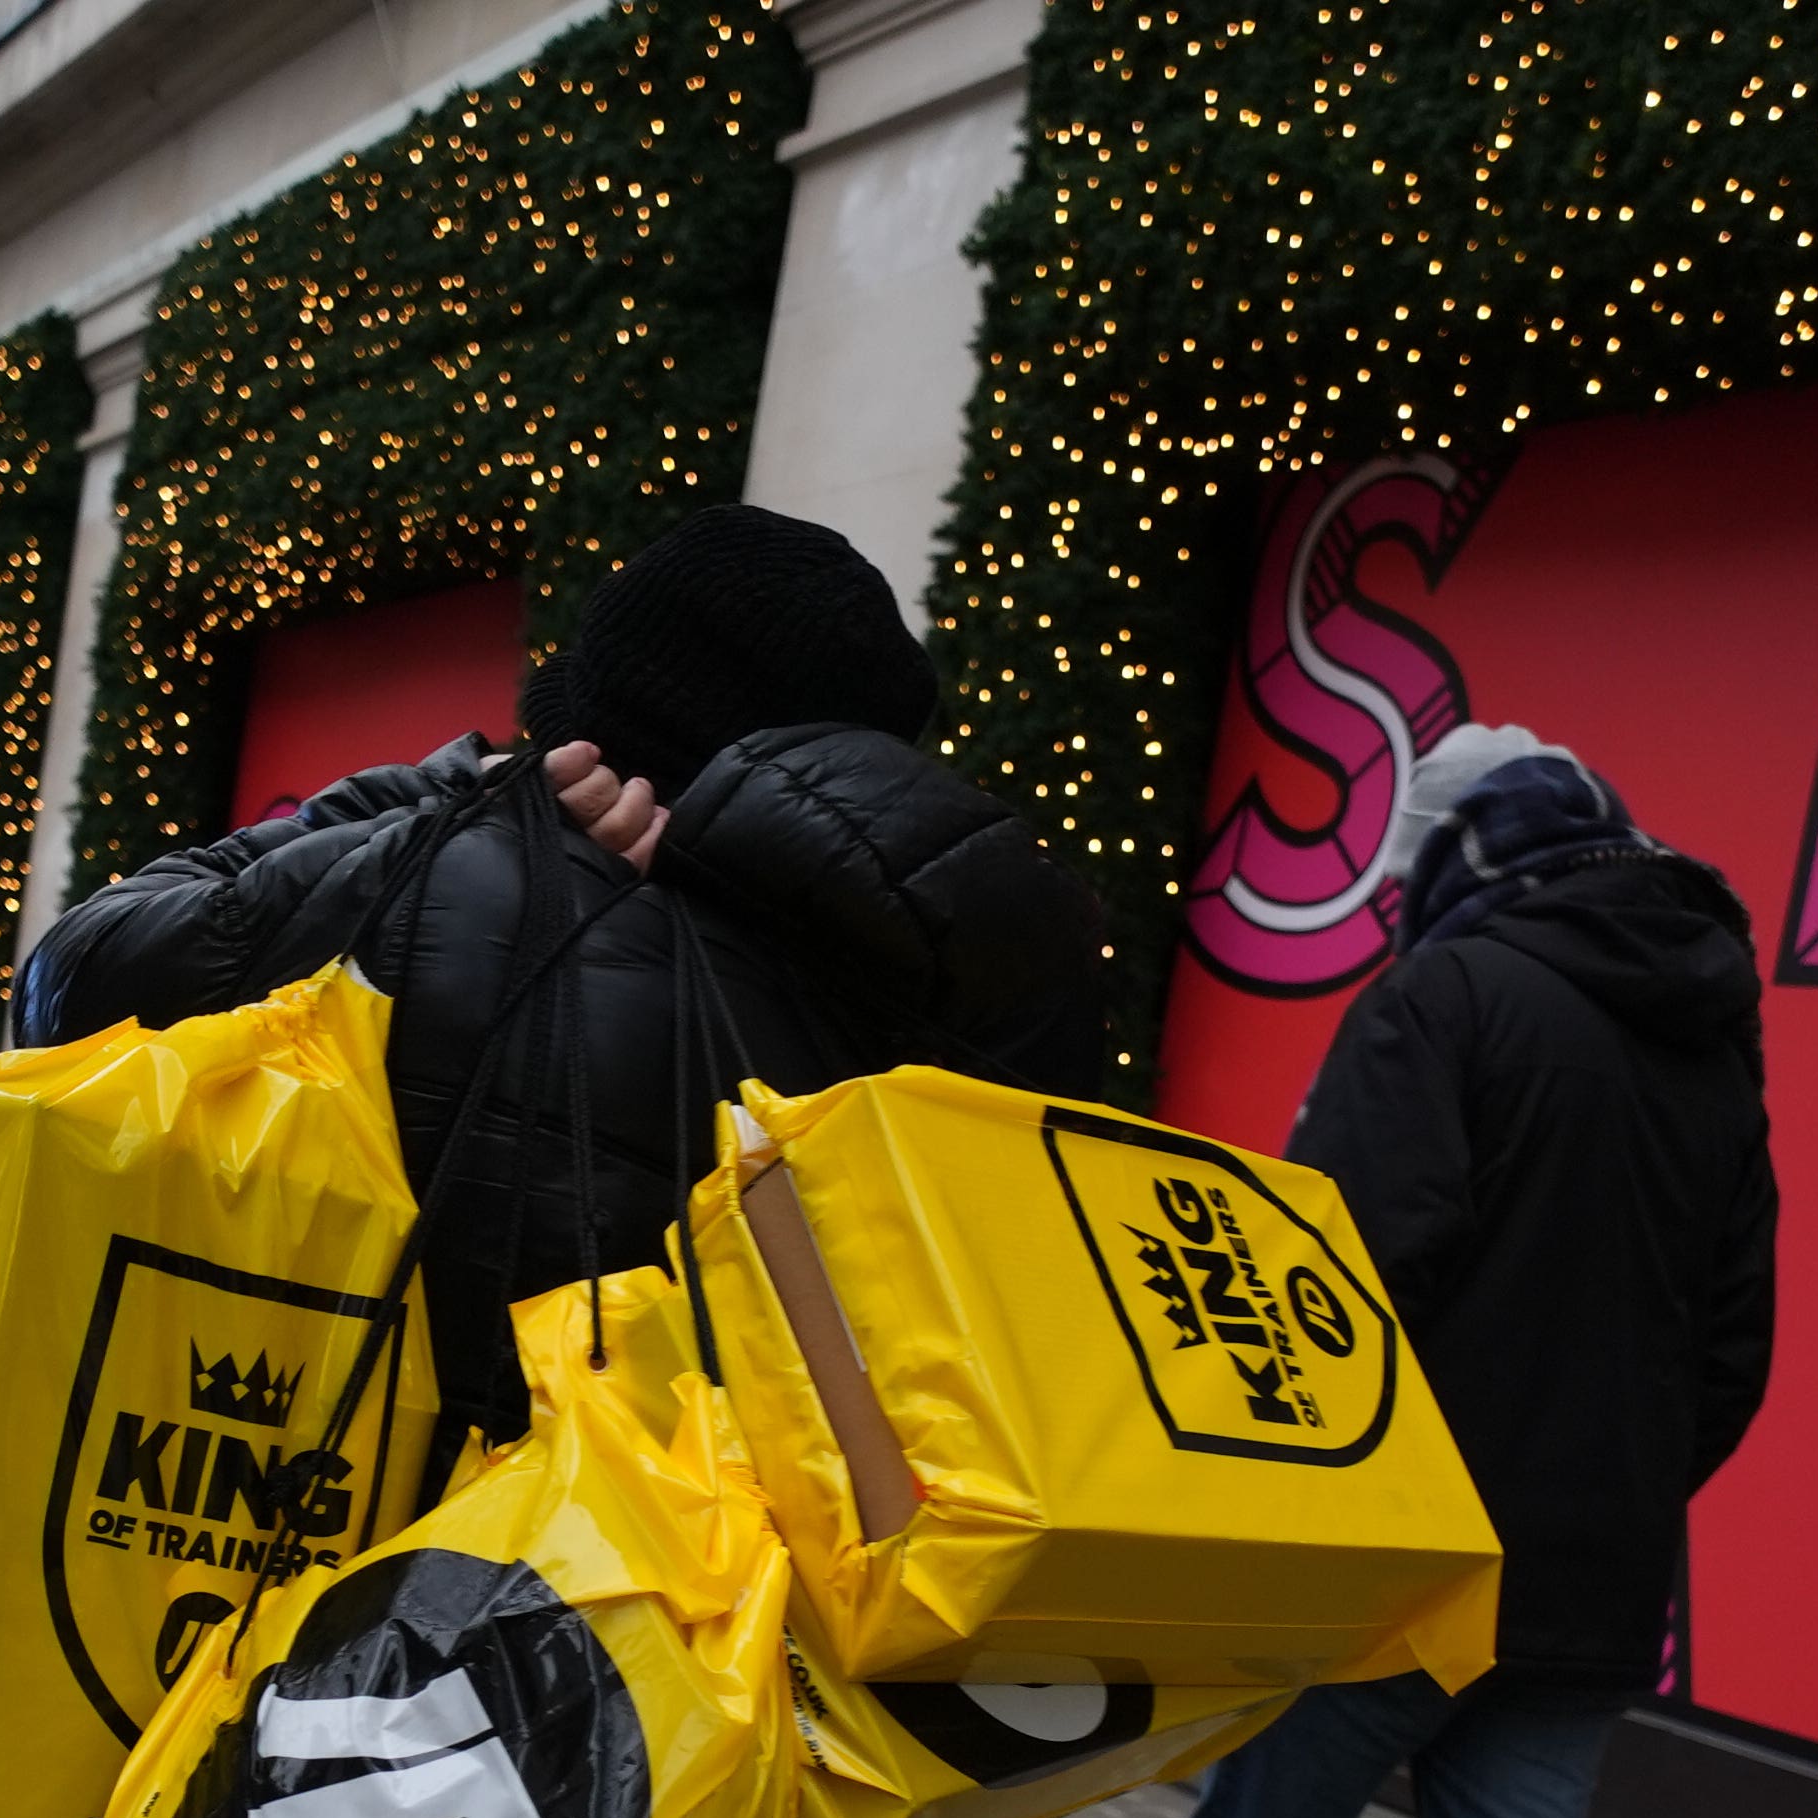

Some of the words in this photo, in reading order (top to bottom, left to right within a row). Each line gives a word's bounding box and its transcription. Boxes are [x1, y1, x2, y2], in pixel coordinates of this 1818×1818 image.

[1153, 1177, 1302, 1427] KING
[1205, 1187, 1304, 1382] TRAINERS
[1292, 1389, 1328, 1430] OF
[86, 1508, 139, 1550] OF
[96, 1411, 354, 1538] KING
